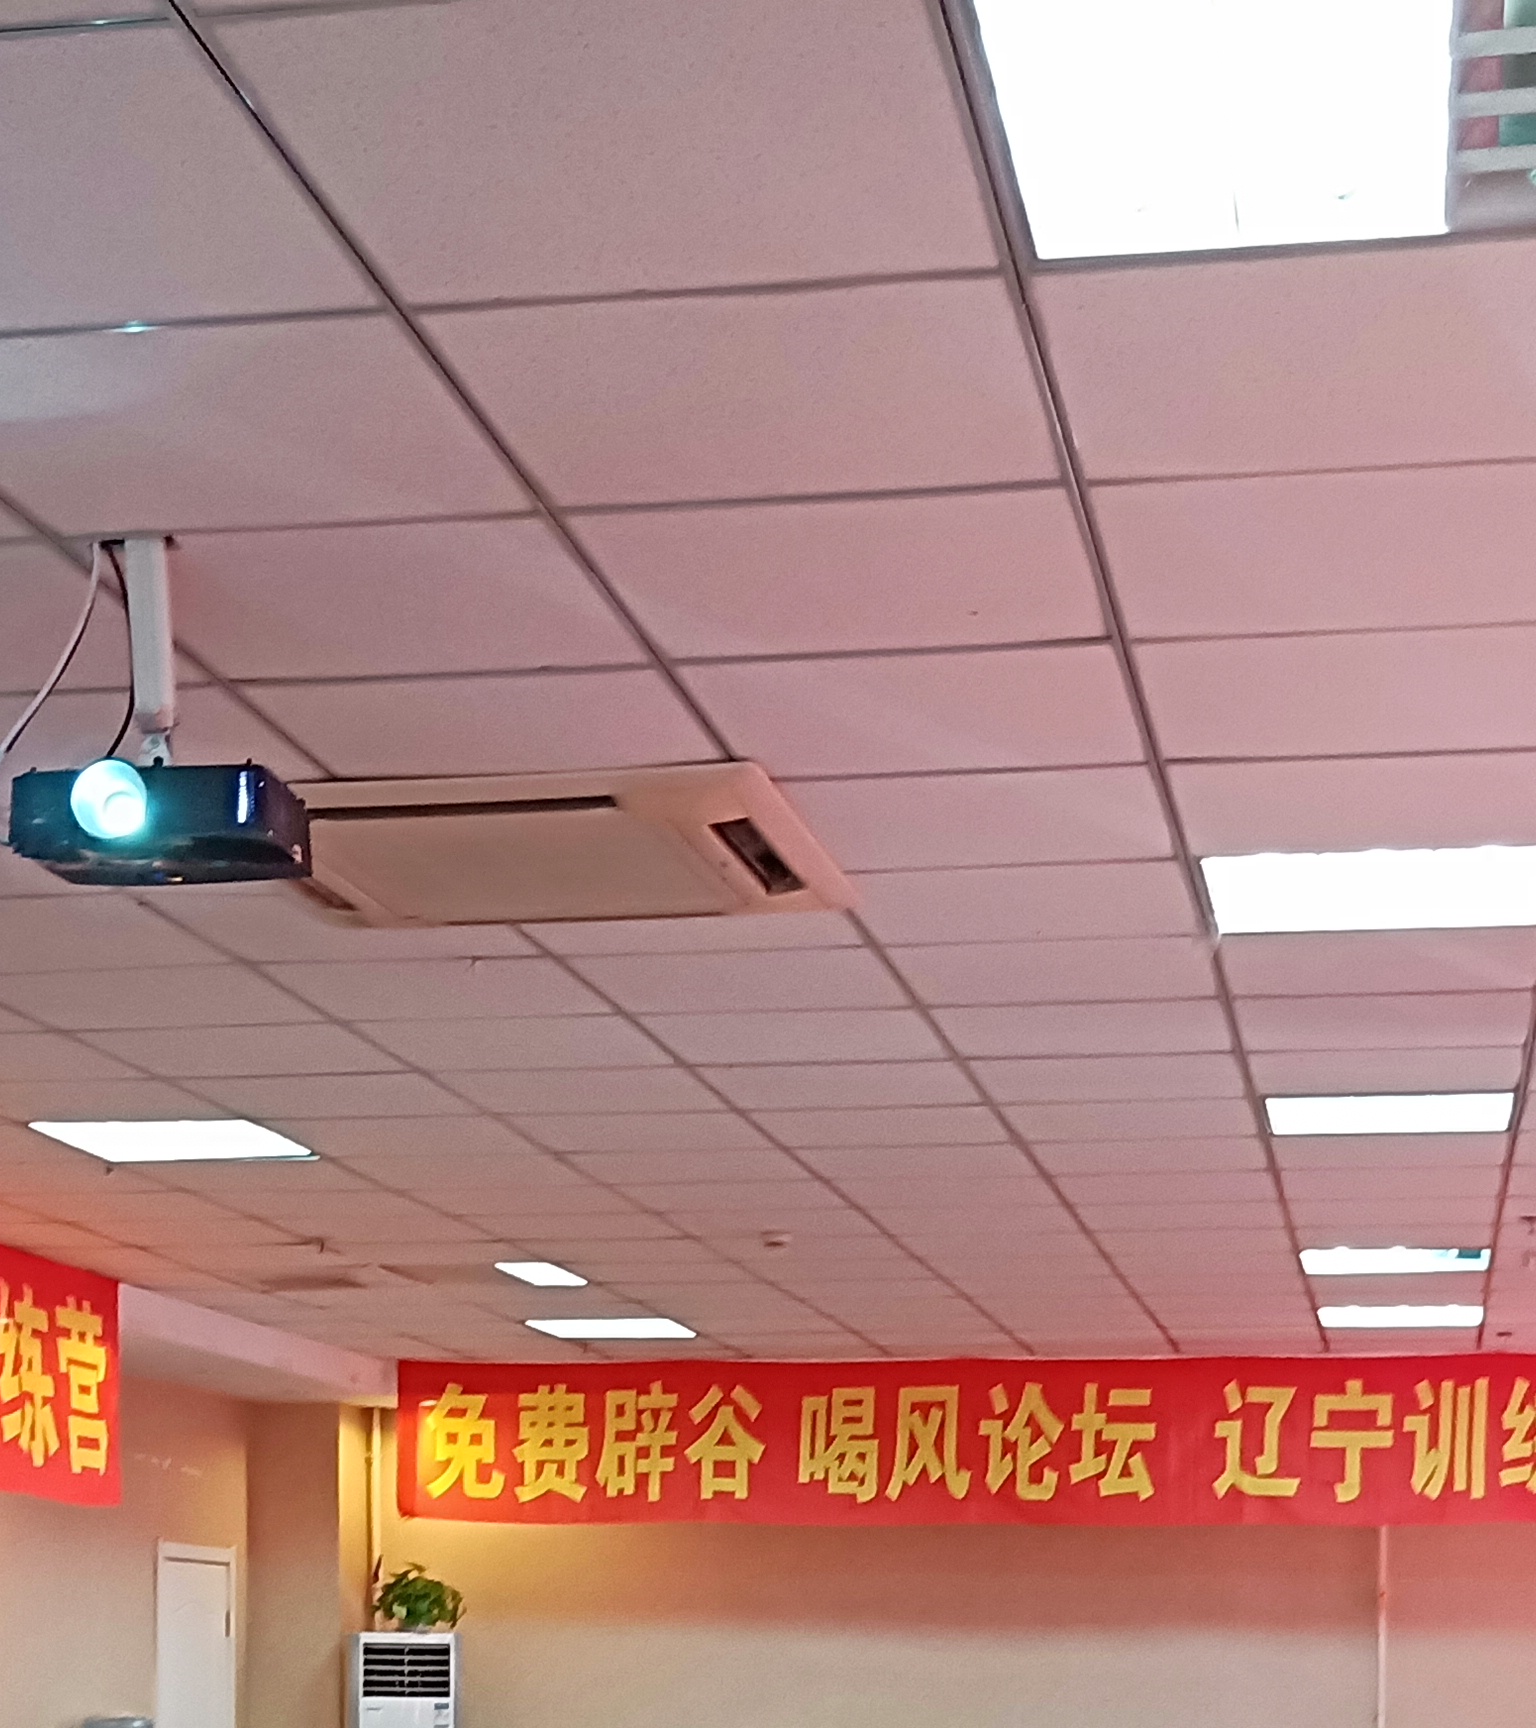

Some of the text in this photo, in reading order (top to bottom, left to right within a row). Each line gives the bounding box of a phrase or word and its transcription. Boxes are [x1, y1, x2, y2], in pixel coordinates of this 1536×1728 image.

[425, 1381, 765, 1503] 免费辟谷
[798, 1382, 1157, 1503] 喝风论坛
